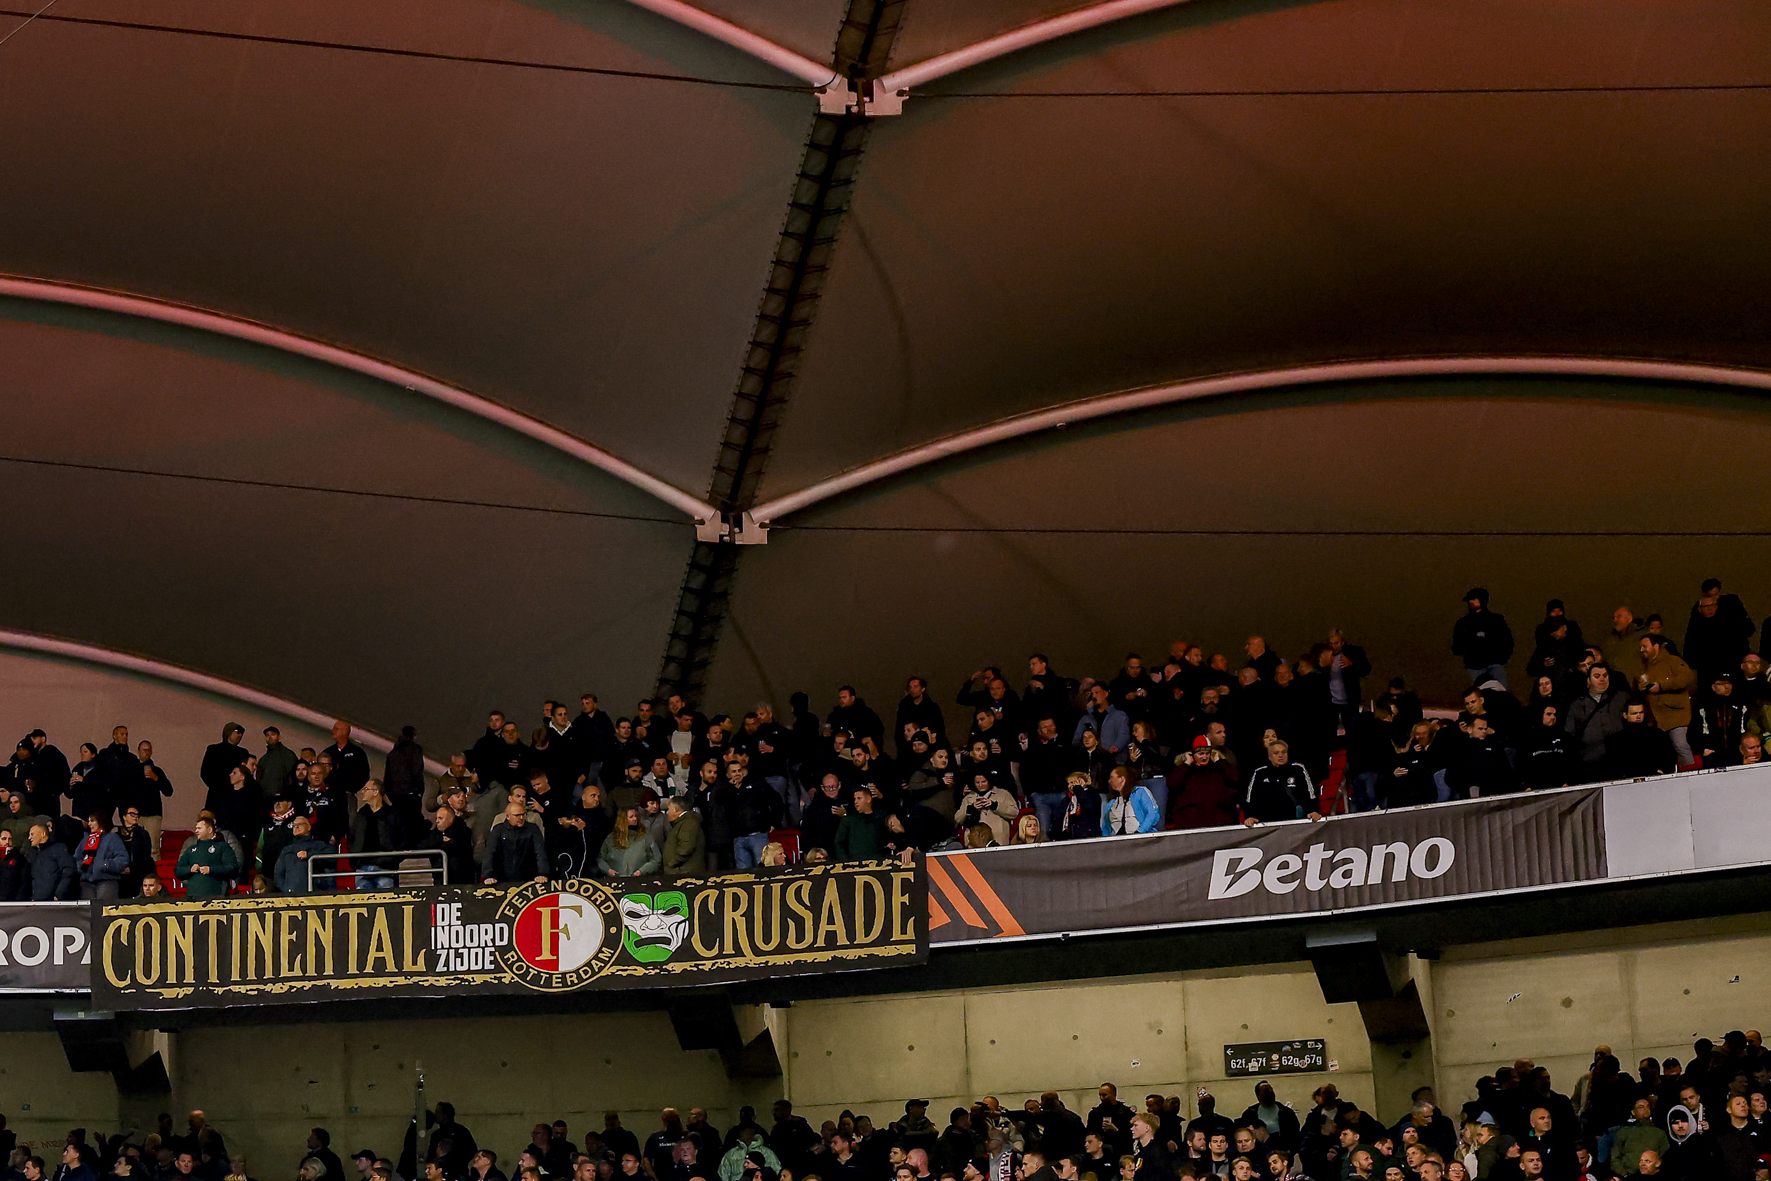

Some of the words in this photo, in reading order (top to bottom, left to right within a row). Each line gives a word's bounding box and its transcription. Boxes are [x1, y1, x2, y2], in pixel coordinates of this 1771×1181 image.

[1207, 837, 1456, 900] Betano
[436, 902, 463, 926] DE
[503, 879, 615, 918] FEYENOORD
[691, 871, 916, 958] CRUSADE
[102, 905, 427, 988] CONTINENTAL
[436, 923, 509, 949] NOORD
[535, 905, 583, 961] F
[435, 947, 495, 972] ZIJDE
[503, 946, 615, 988] ROTTERDAM
